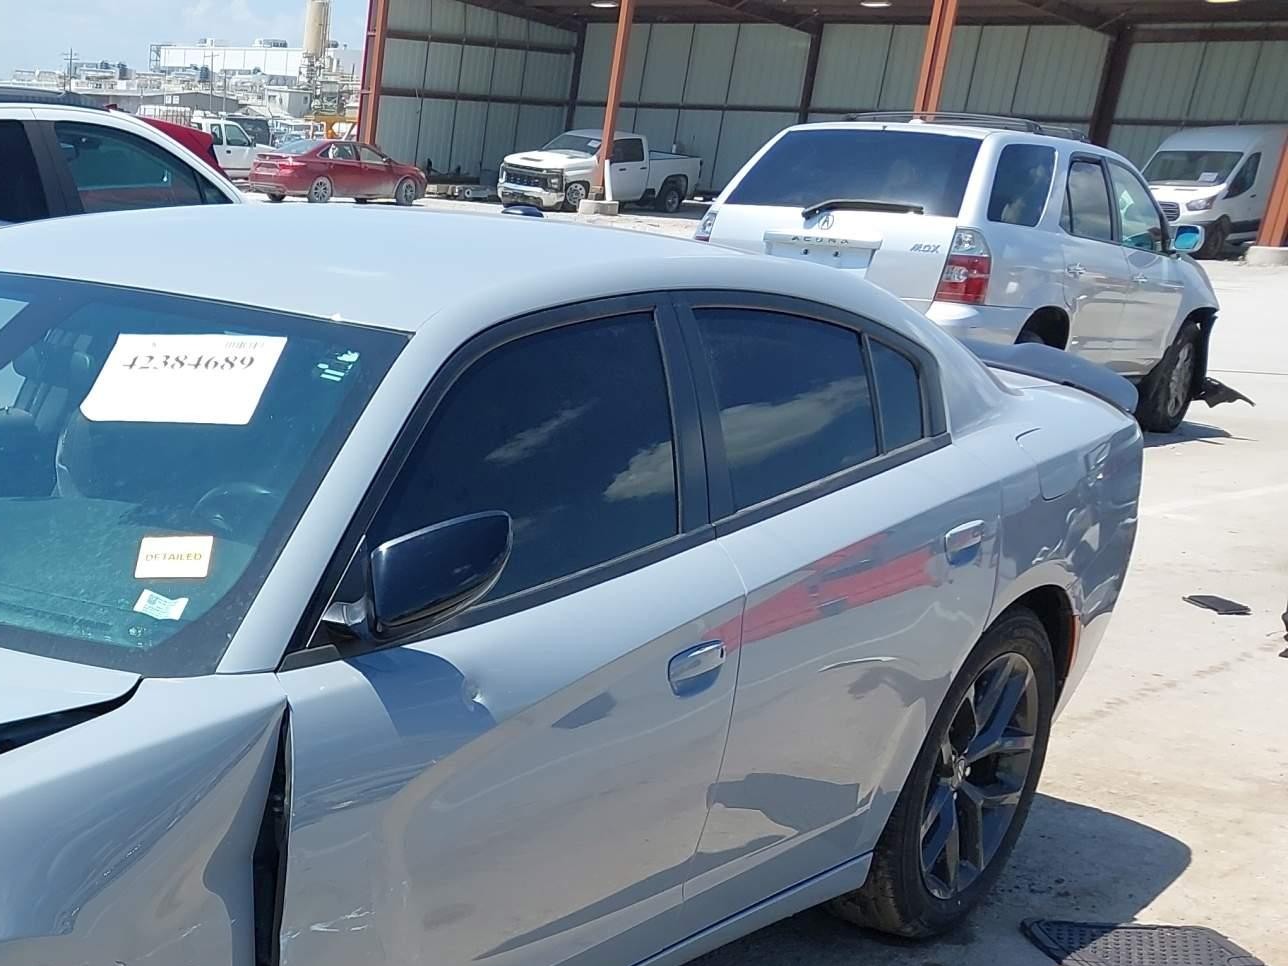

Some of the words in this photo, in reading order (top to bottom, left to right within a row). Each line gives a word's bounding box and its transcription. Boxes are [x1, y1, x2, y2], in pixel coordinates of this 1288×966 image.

[791, 235, 849, 245] ACURA
[909, 243, 941, 254] MDX
[122, 354, 255, 370] 42384689
[145, 551, 203, 562] DETAILED
